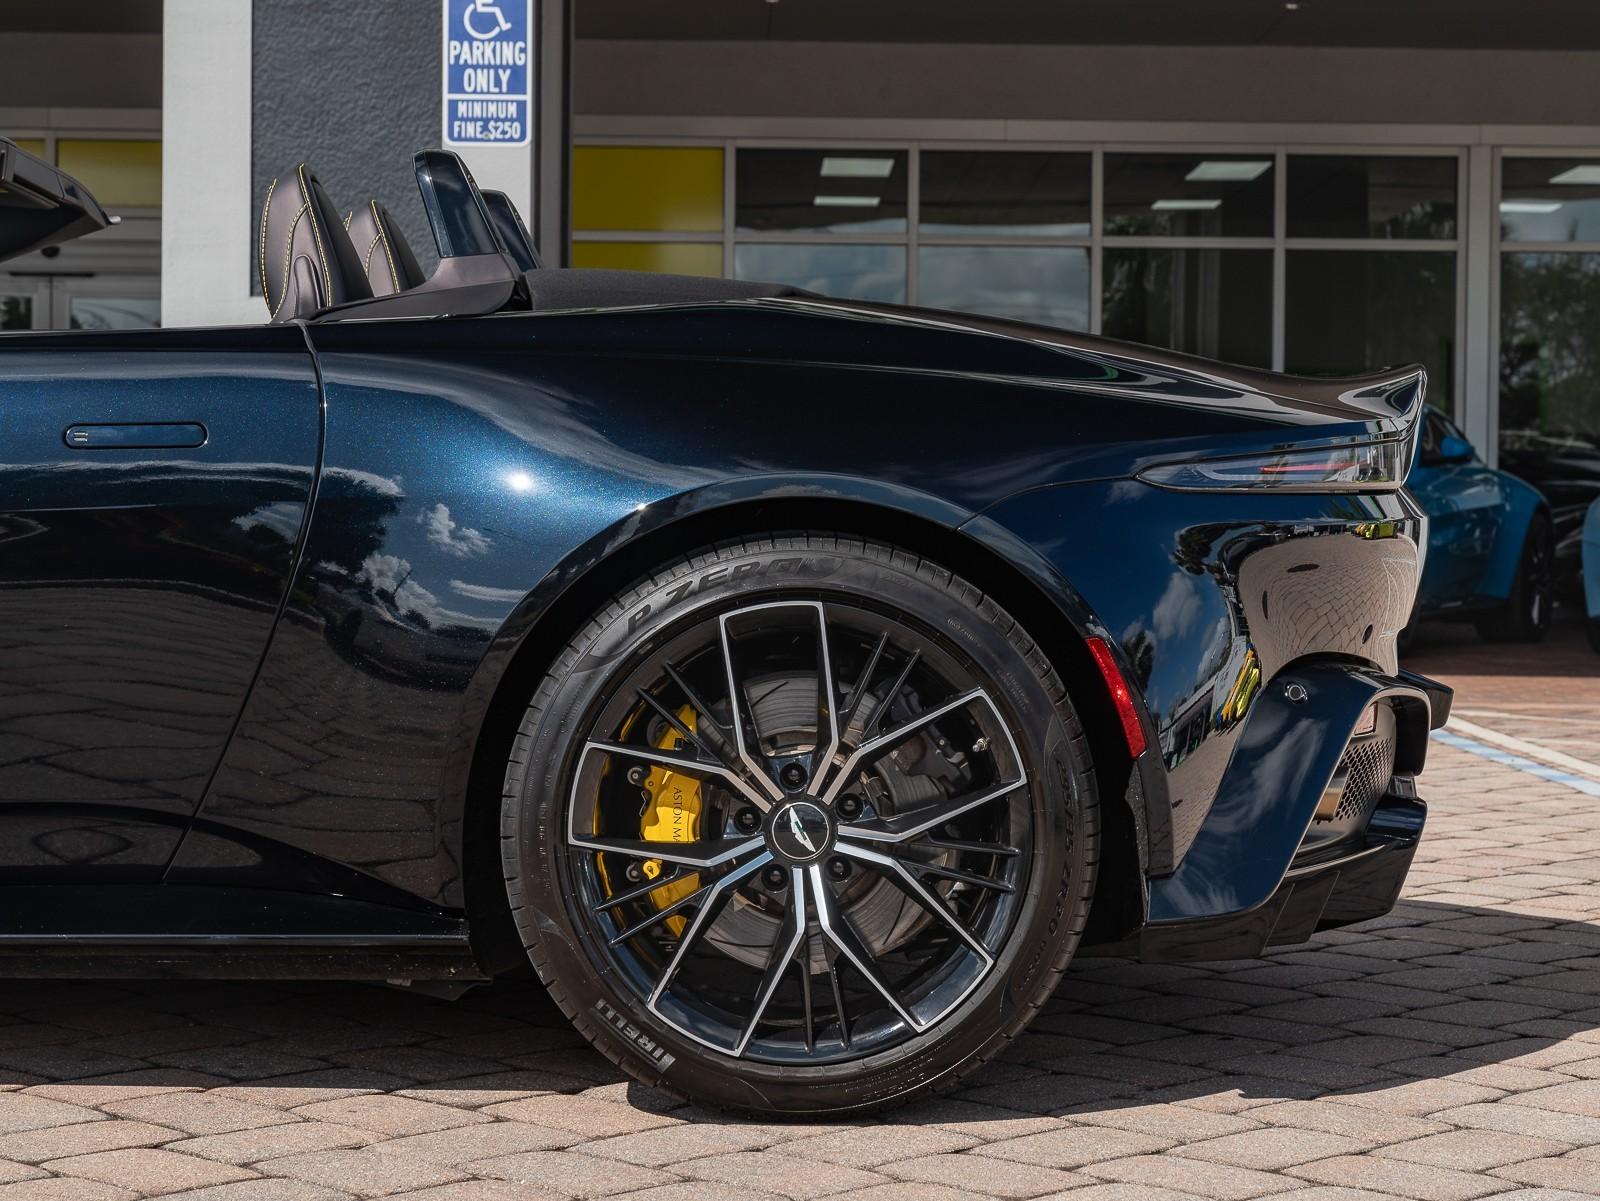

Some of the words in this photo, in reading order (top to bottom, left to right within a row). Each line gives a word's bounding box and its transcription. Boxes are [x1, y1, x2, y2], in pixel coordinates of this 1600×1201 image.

[449, 40, 526, 66] PARKING
[463, 67, 511, 93] ONLY
[457, 101, 517, 119] MINIMUM
[453, 121, 484, 139] FINE
[488, 120, 521, 140] $250
[627, 603, 652, 635] P
[672, 785, 683, 825] ASTON
[591, 998, 676, 1074] PIRELLI
